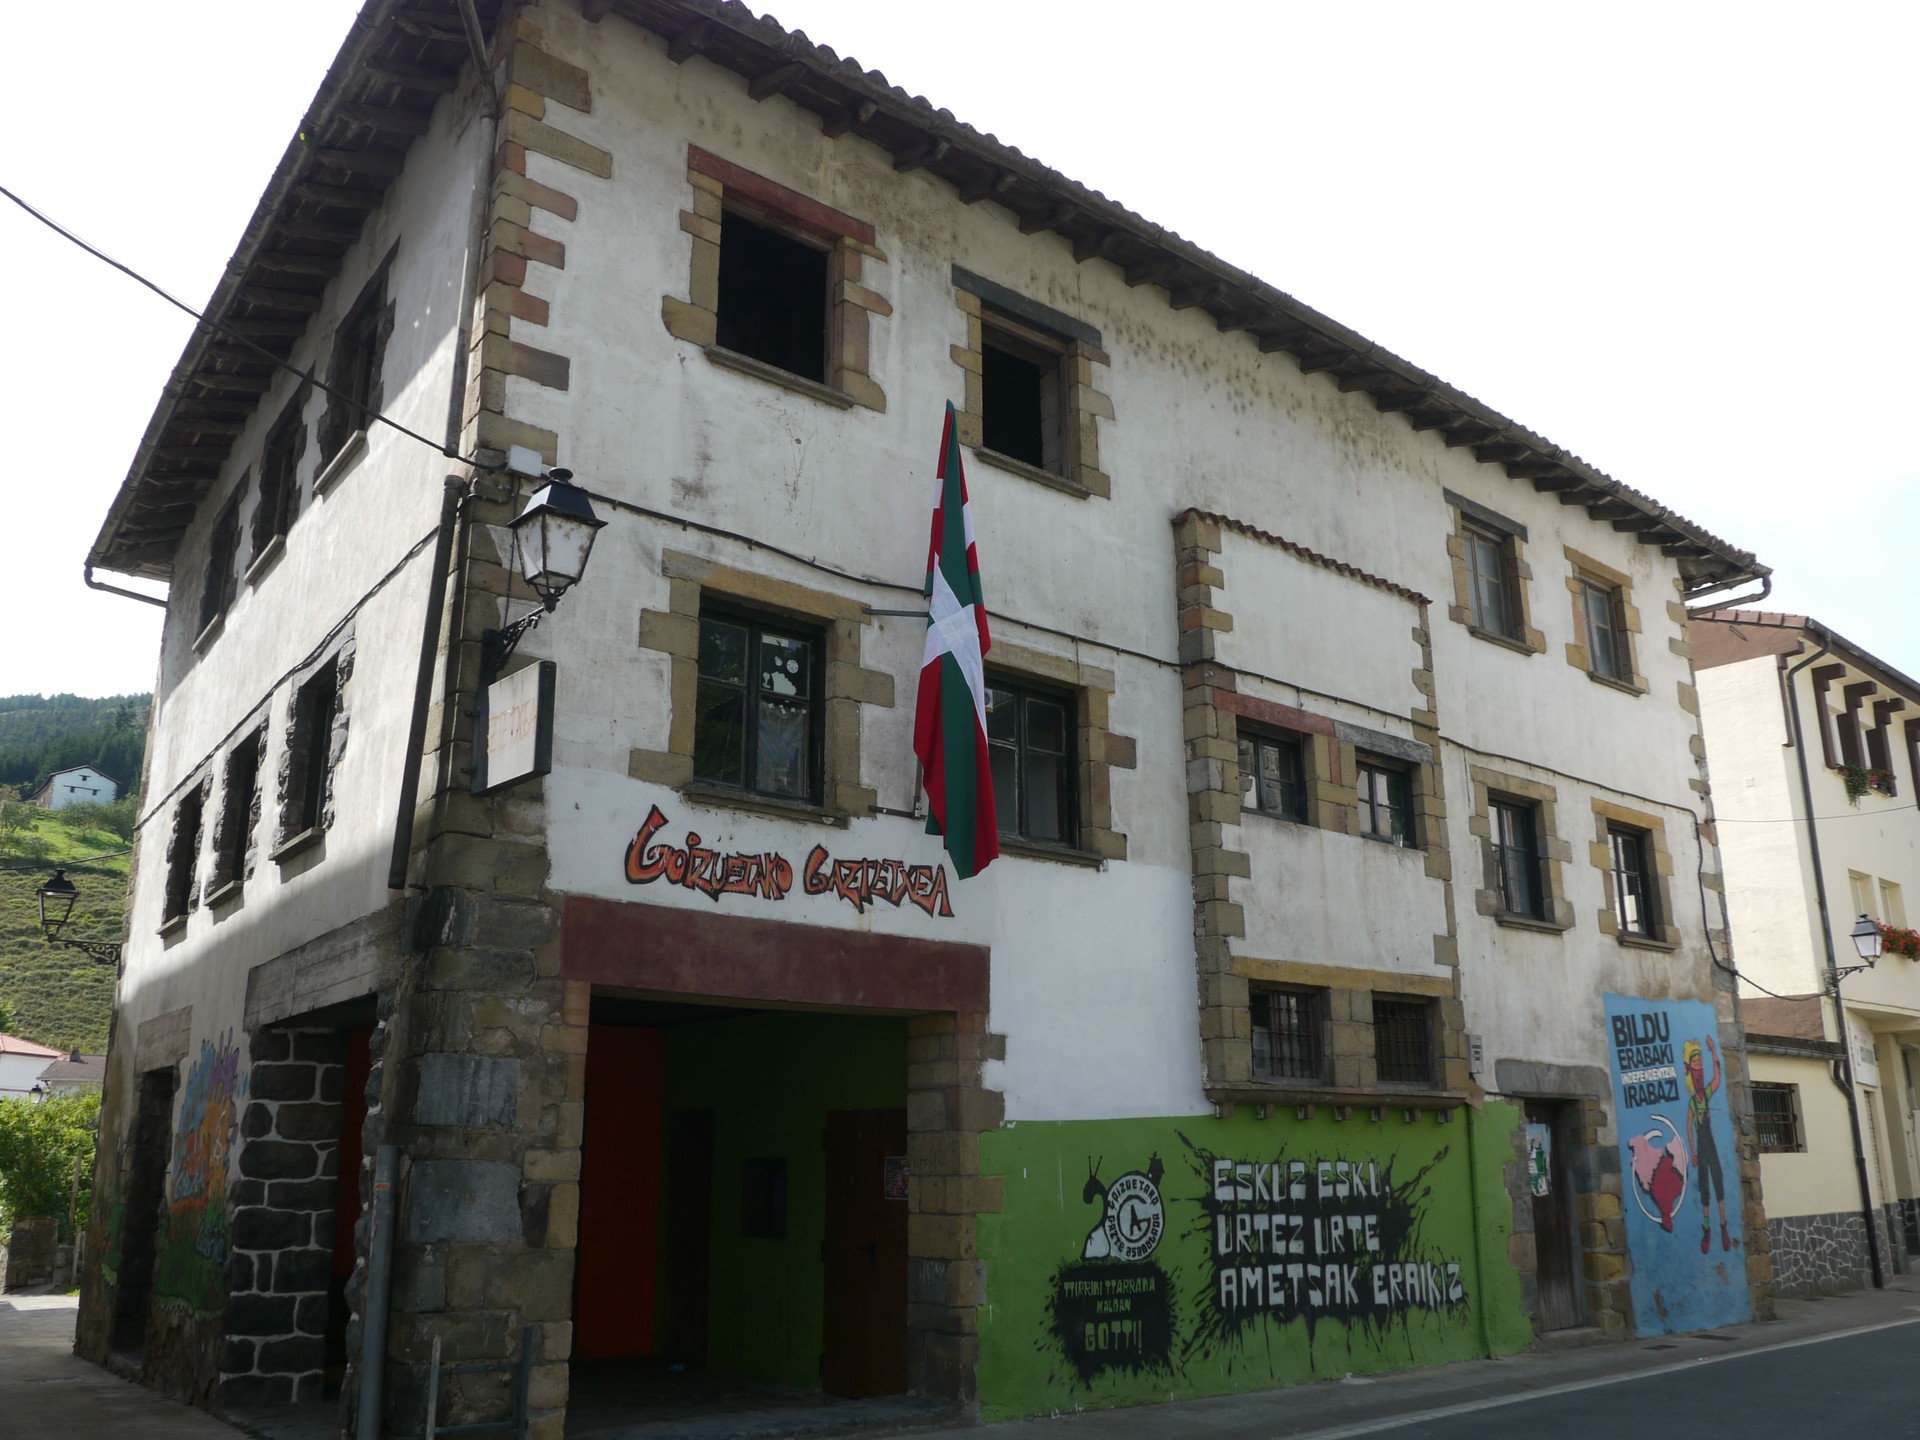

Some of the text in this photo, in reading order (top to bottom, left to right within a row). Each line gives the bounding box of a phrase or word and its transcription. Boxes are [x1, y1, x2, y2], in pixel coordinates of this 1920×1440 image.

[803, 843, 955, 918] GAZTETXEA
[1611, 1011, 1670, 1047] BILDU
[1617, 1043, 1674, 1070] ERABAKI
[1623, 1079, 1680, 1109] IRABAZI
[1214, 1159, 1306, 1202] ESKUZ
[1217, 1213, 1380, 1255] URTEZ URTE
[1220, 1261, 1463, 1307] AMETSAK ERAIKIZ
